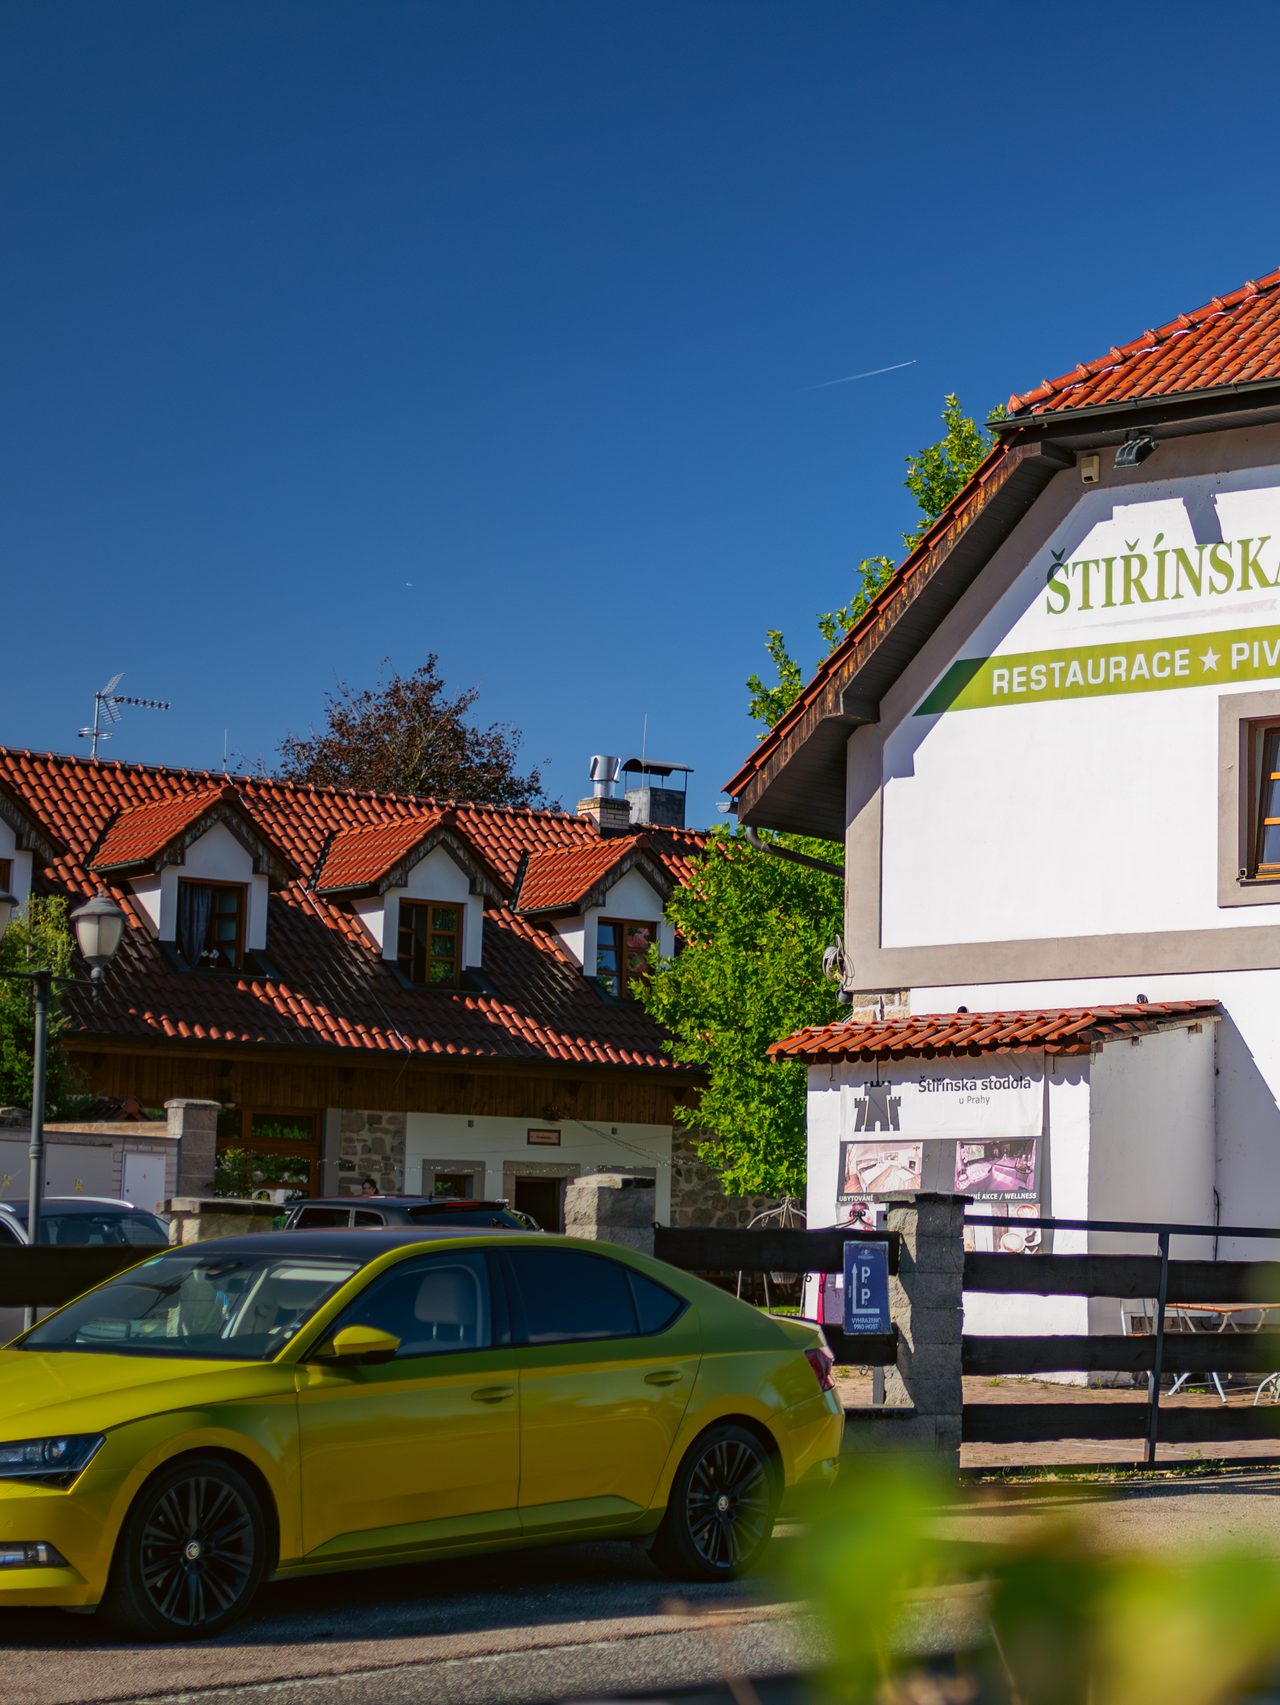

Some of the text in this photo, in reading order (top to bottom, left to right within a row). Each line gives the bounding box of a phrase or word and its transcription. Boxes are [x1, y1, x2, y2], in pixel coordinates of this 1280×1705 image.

[992, 648, 1190, 696] RESTAURACE
[918, 1075, 1031, 1093] Štiřínská stodola
[966, 1095, 991, 1105] Prahy
[838, 1194, 874, 1202] UBYTOVÁNÍ
[1004, 1192, 1037, 1200] WELLNESS
